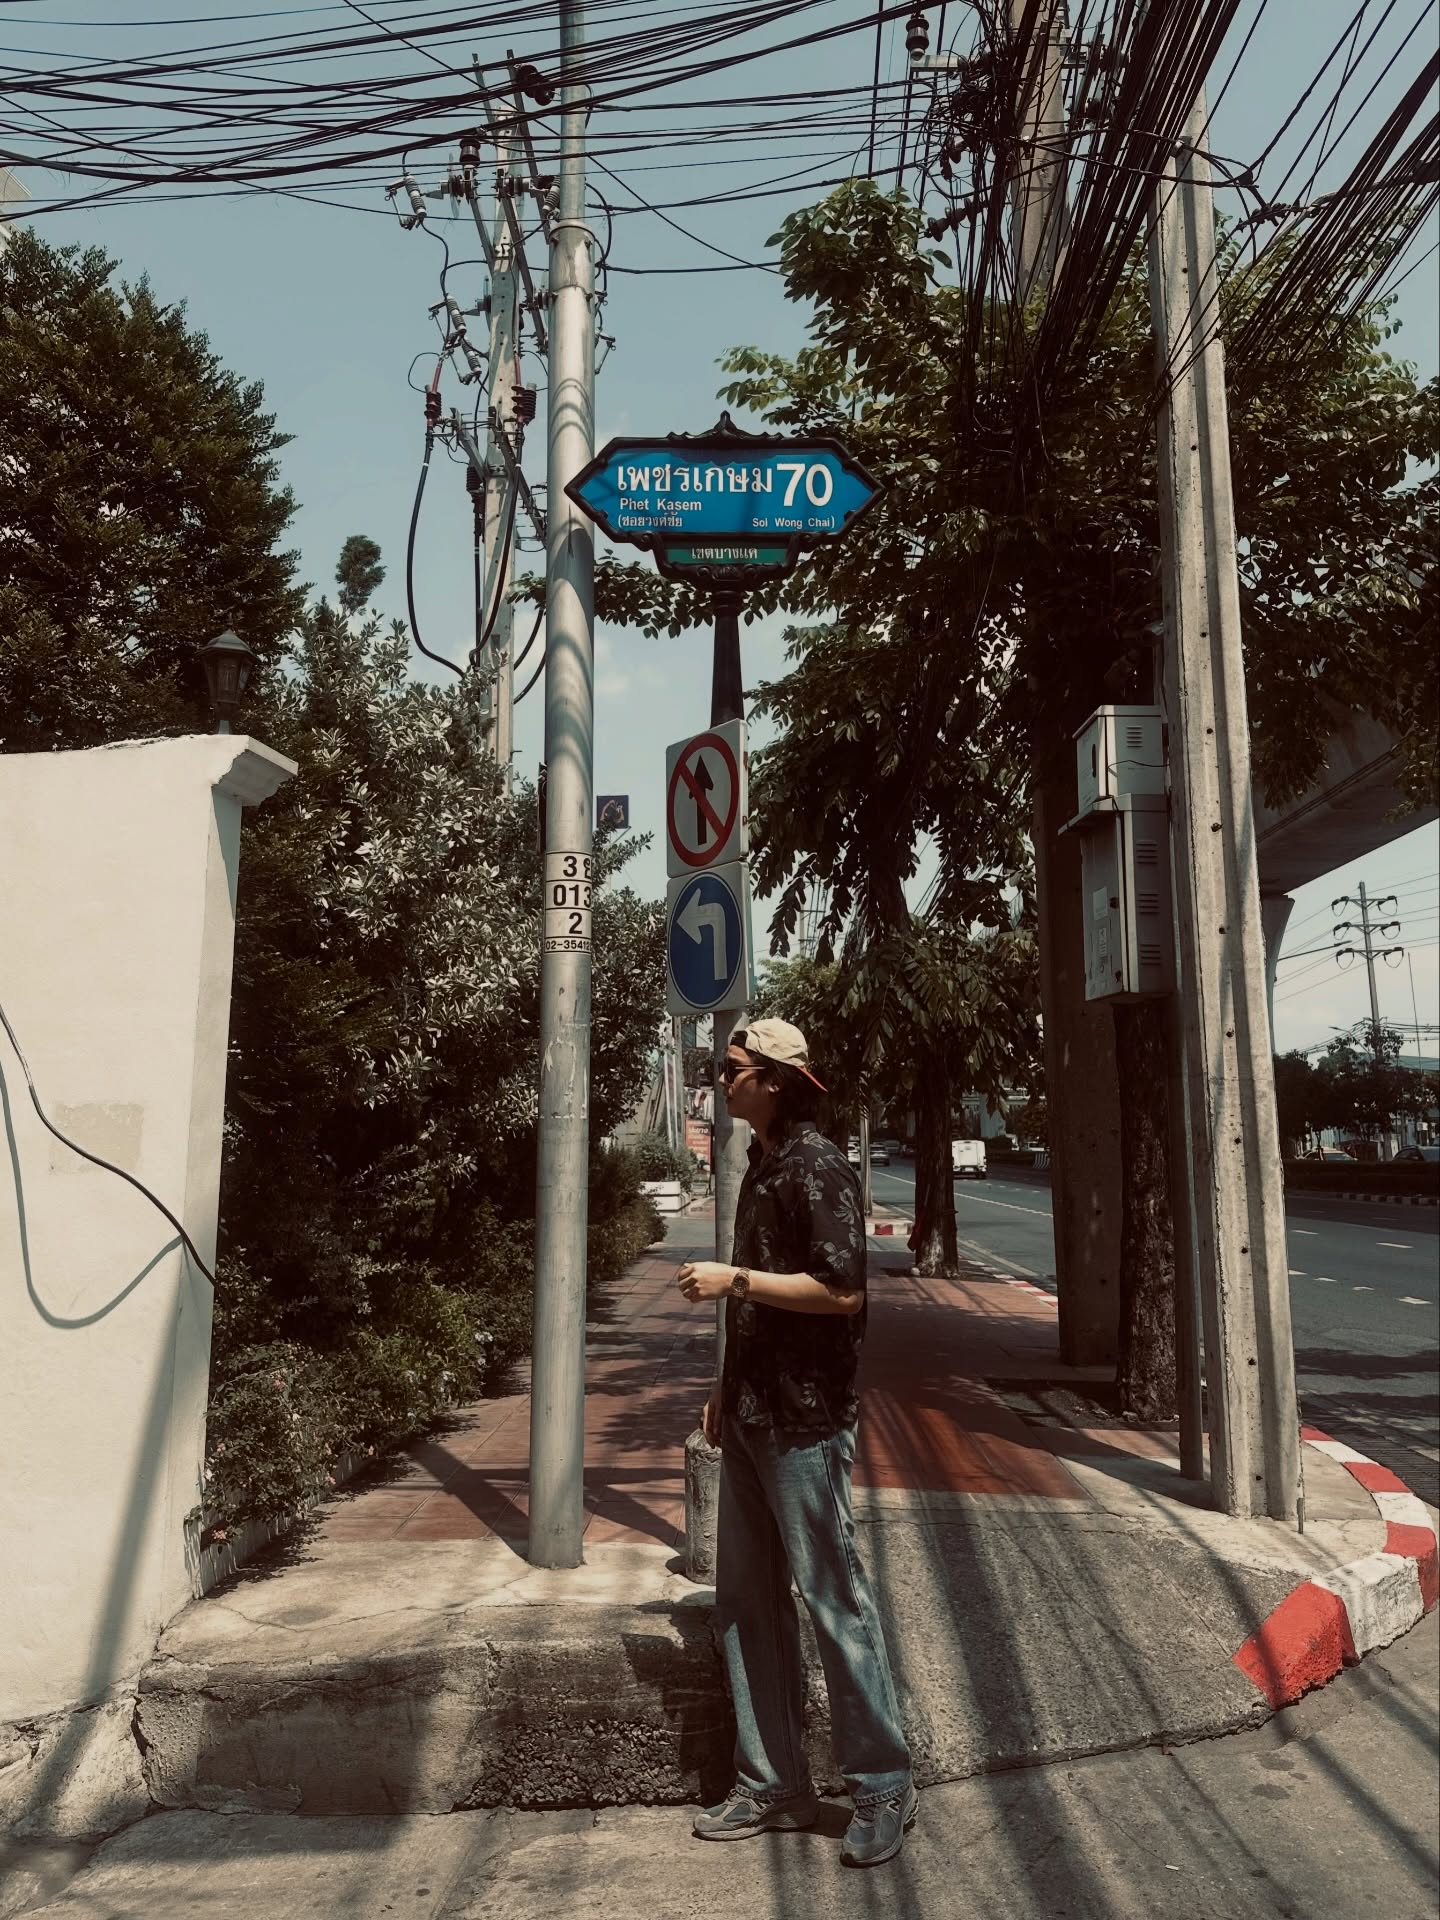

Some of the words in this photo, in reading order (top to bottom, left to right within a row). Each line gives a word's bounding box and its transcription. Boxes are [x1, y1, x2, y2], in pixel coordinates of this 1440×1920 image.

[620, 498, 649, 510] Phet
[657, 498, 702, 511] Kasem
[775, 517, 803, 529] Wong
[807, 515, 835, 529] Chai)
[568, 912, 583, 934] 2
